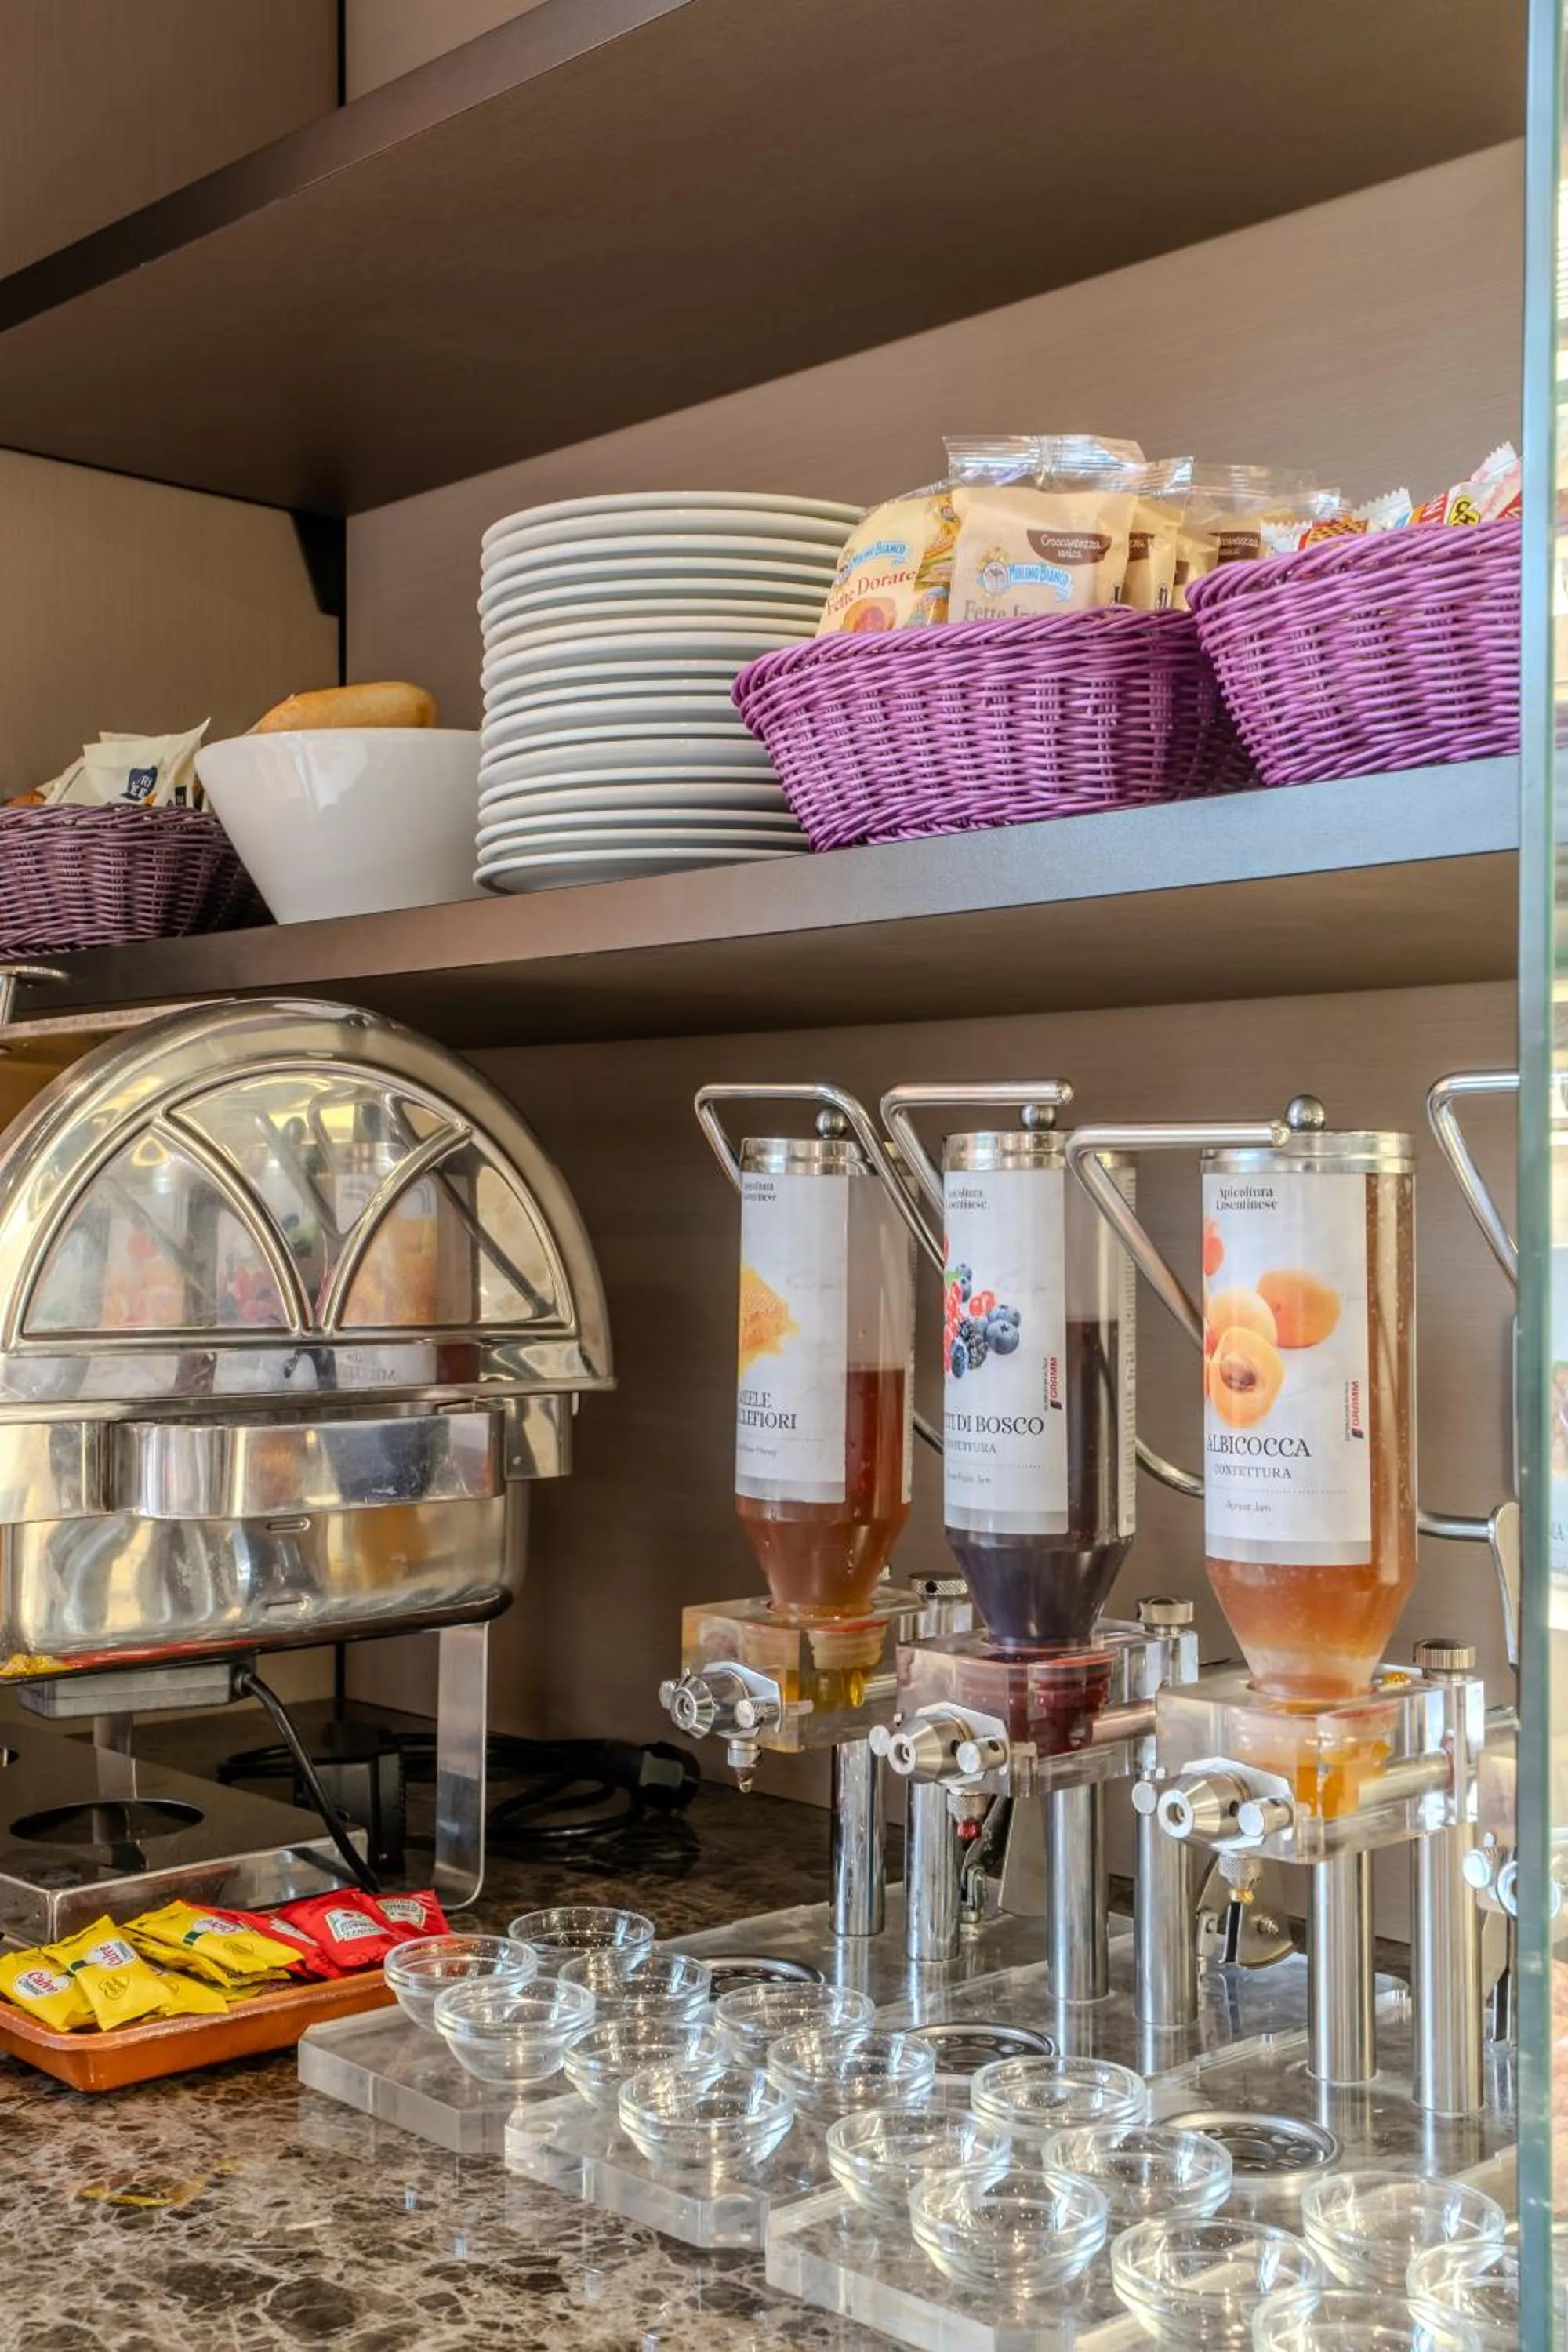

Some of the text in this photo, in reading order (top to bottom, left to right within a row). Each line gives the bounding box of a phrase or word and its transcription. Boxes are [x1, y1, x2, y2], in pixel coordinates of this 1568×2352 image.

[957, 1414, 972, 1433] DI
[975, 1415, 1045, 1436] BOSCO
[1207, 1433, 1312, 1457] ALBICOCCA
